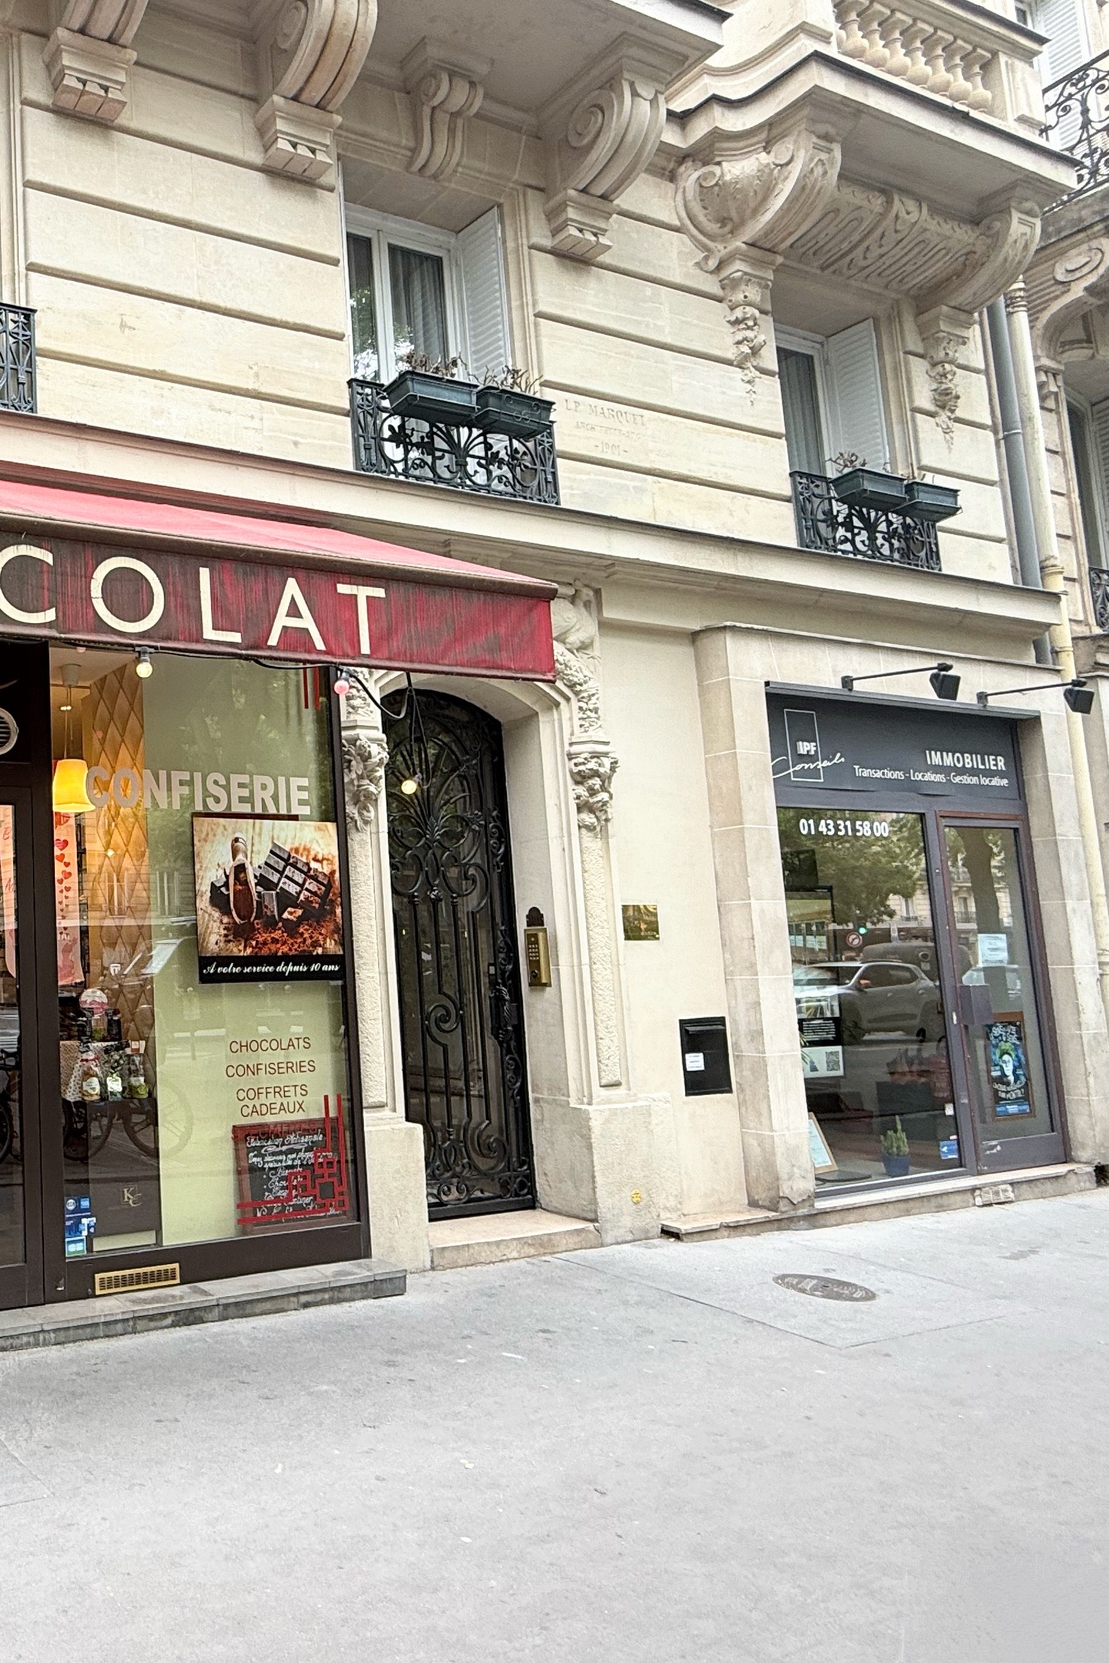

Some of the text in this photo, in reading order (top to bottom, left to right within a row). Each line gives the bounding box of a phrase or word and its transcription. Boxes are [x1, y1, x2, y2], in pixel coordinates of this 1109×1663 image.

[797, 741, 817, 755] IPF
[925, 750, 1006, 771] IMMOBILIER
[853, 765, 905, 780] Transactions
[910, 769, 946, 783] Locations
[950, 773, 979, 785] Gestion
[980, 774, 1009, 787] locative
[87, 765, 311, 816] CONFISERIE
[799, 818, 889, 837] 01 43 31 58 00
[217, 962, 243, 974] votre
[242, 963, 275, 973] service
[275, 960, 308, 977] depuis
[310, 962, 321, 972] 10
[321, 964, 341, 972] ans
[229, 1036, 312, 1054] CHOCOLATS
[225, 1059, 316, 1078] CONFISERIES
[236, 1084, 309, 1102] COFFRETS
[240, 1100, 306, 1118] CADEAUX
